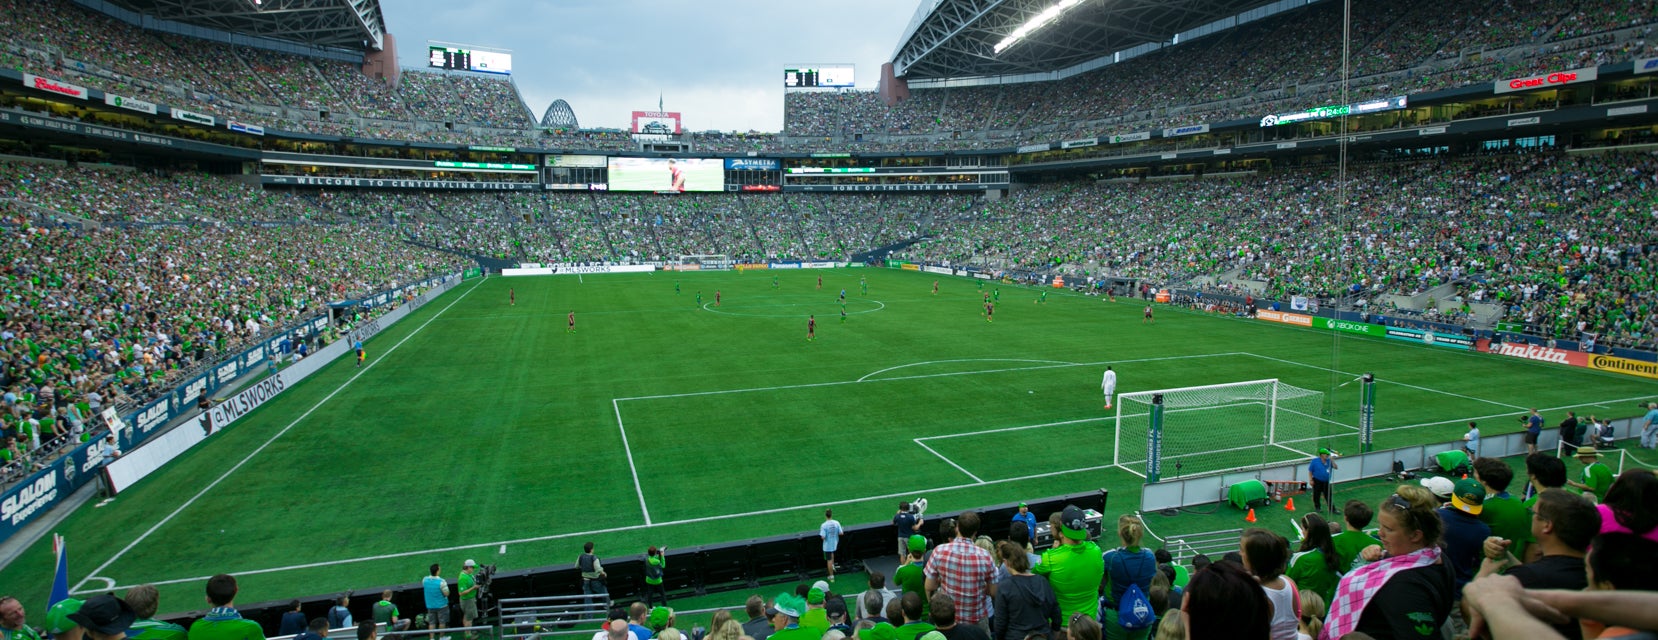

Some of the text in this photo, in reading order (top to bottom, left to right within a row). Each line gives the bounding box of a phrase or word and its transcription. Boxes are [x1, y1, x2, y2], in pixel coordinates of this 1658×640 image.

[1509, 72, 1577, 89] Great Clips
[1327, 104, 1349, 116] 24:03
[1176, 126, 1203, 134] BOEING
[297, 178, 360, 186] WELCOME
[392, 181, 476, 189] CENTURYLINK
[213, 373, 285, 429] @MLSWORKS
[137, 399, 169, 429] SLALOM
[1, 470, 57, 522] SLALOM
[12, 489, 58, 526] Experience
